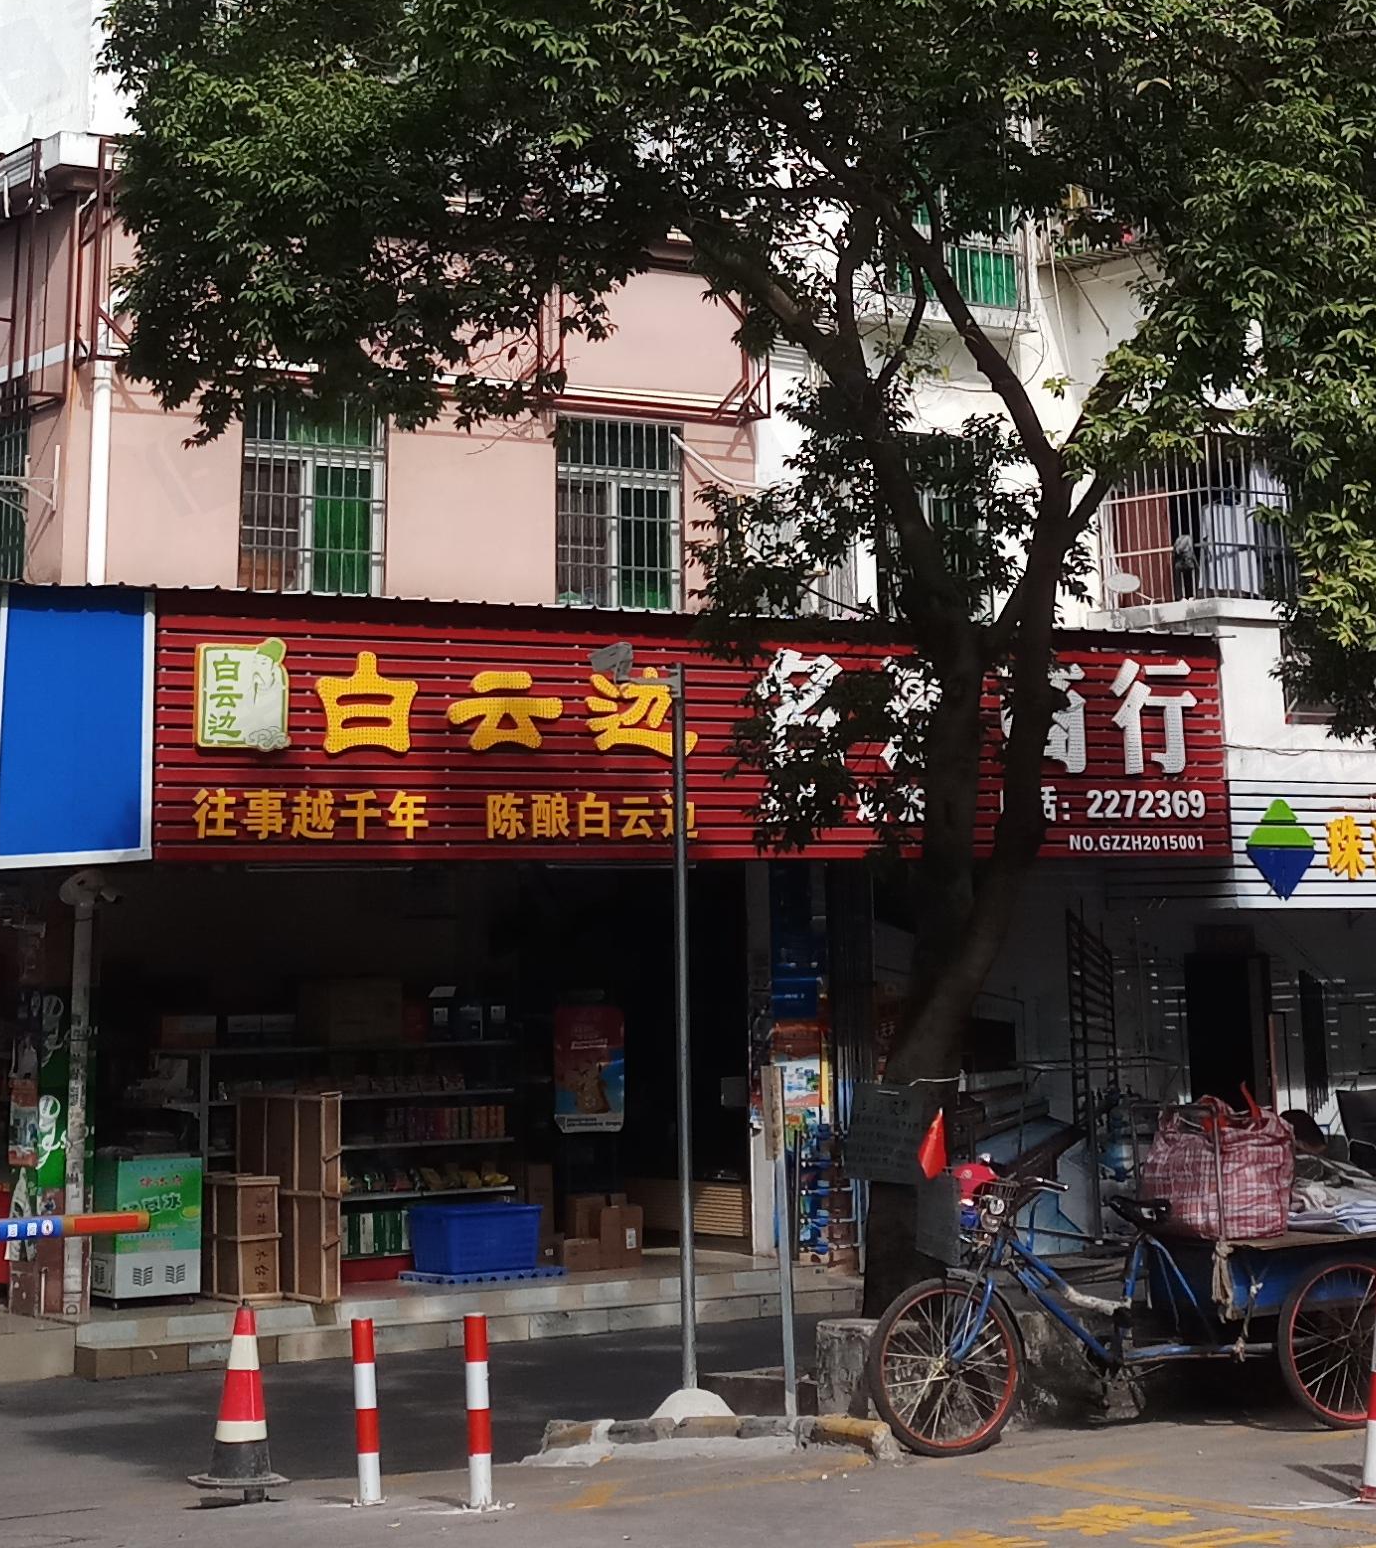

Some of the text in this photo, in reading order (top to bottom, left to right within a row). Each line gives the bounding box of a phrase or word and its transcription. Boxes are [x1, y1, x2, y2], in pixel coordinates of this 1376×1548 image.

[207, 652, 242, 740] 白云边
[314, 651, 698, 757] 白云边
[192, 788, 699, 840] 往事越千年 陈酿白云边
[1086, 789, 1206, 820] 2272369
[1068, 835, 1205, 851] NO.GZZH2015001
